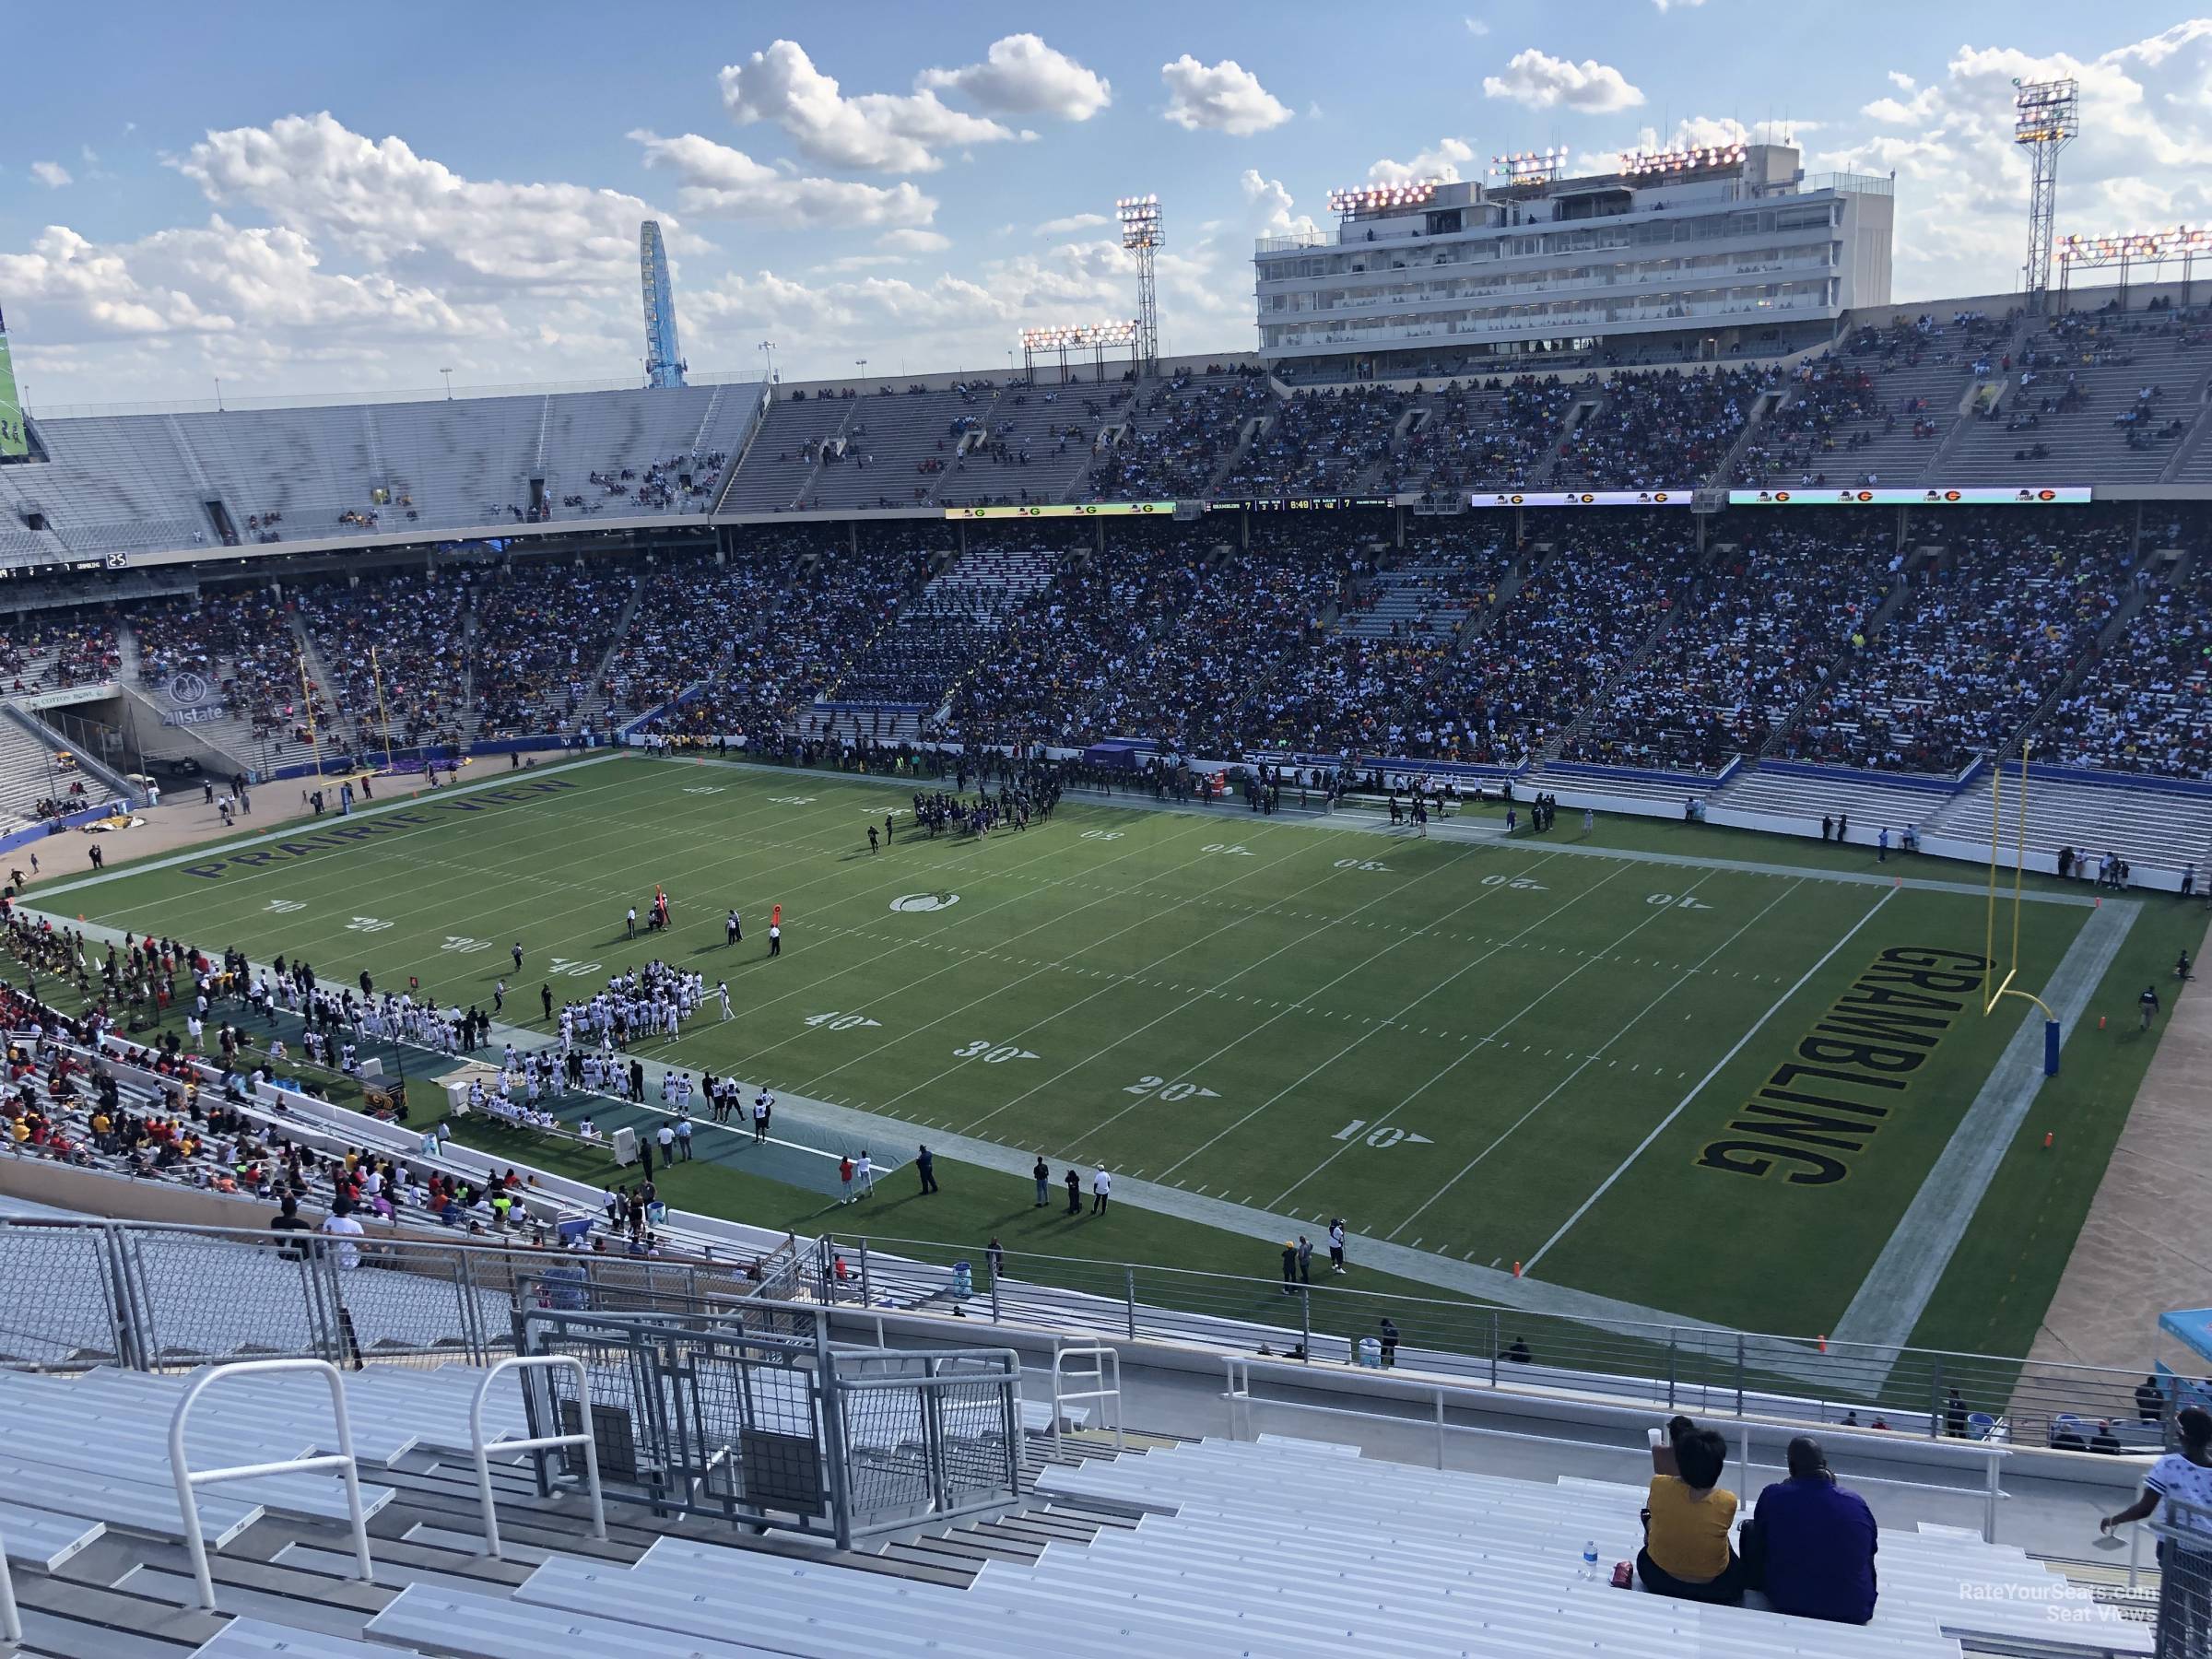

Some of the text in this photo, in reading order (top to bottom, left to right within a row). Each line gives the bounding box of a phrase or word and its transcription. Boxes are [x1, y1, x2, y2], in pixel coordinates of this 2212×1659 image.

[109, 554, 126, 566] 25
[162, 706, 223, 726] Allstate
[182, 779, 581, 879] PRAIRIE VIEW
[1481, 875, 1538, 888] 20
[1646, 893, 1700, 908] 10
[441, 937, 493, 953] 30
[547, 960, 603, 976] 40
[804, 1012, 865, 1030] 40
[953, 1041, 1018, 1063] 30
[1696, 947, 1997, 1185] GRAMBLING
[1122, 1076, 1196, 1101] 20
[1331, 1119, 1405, 1148] 10
